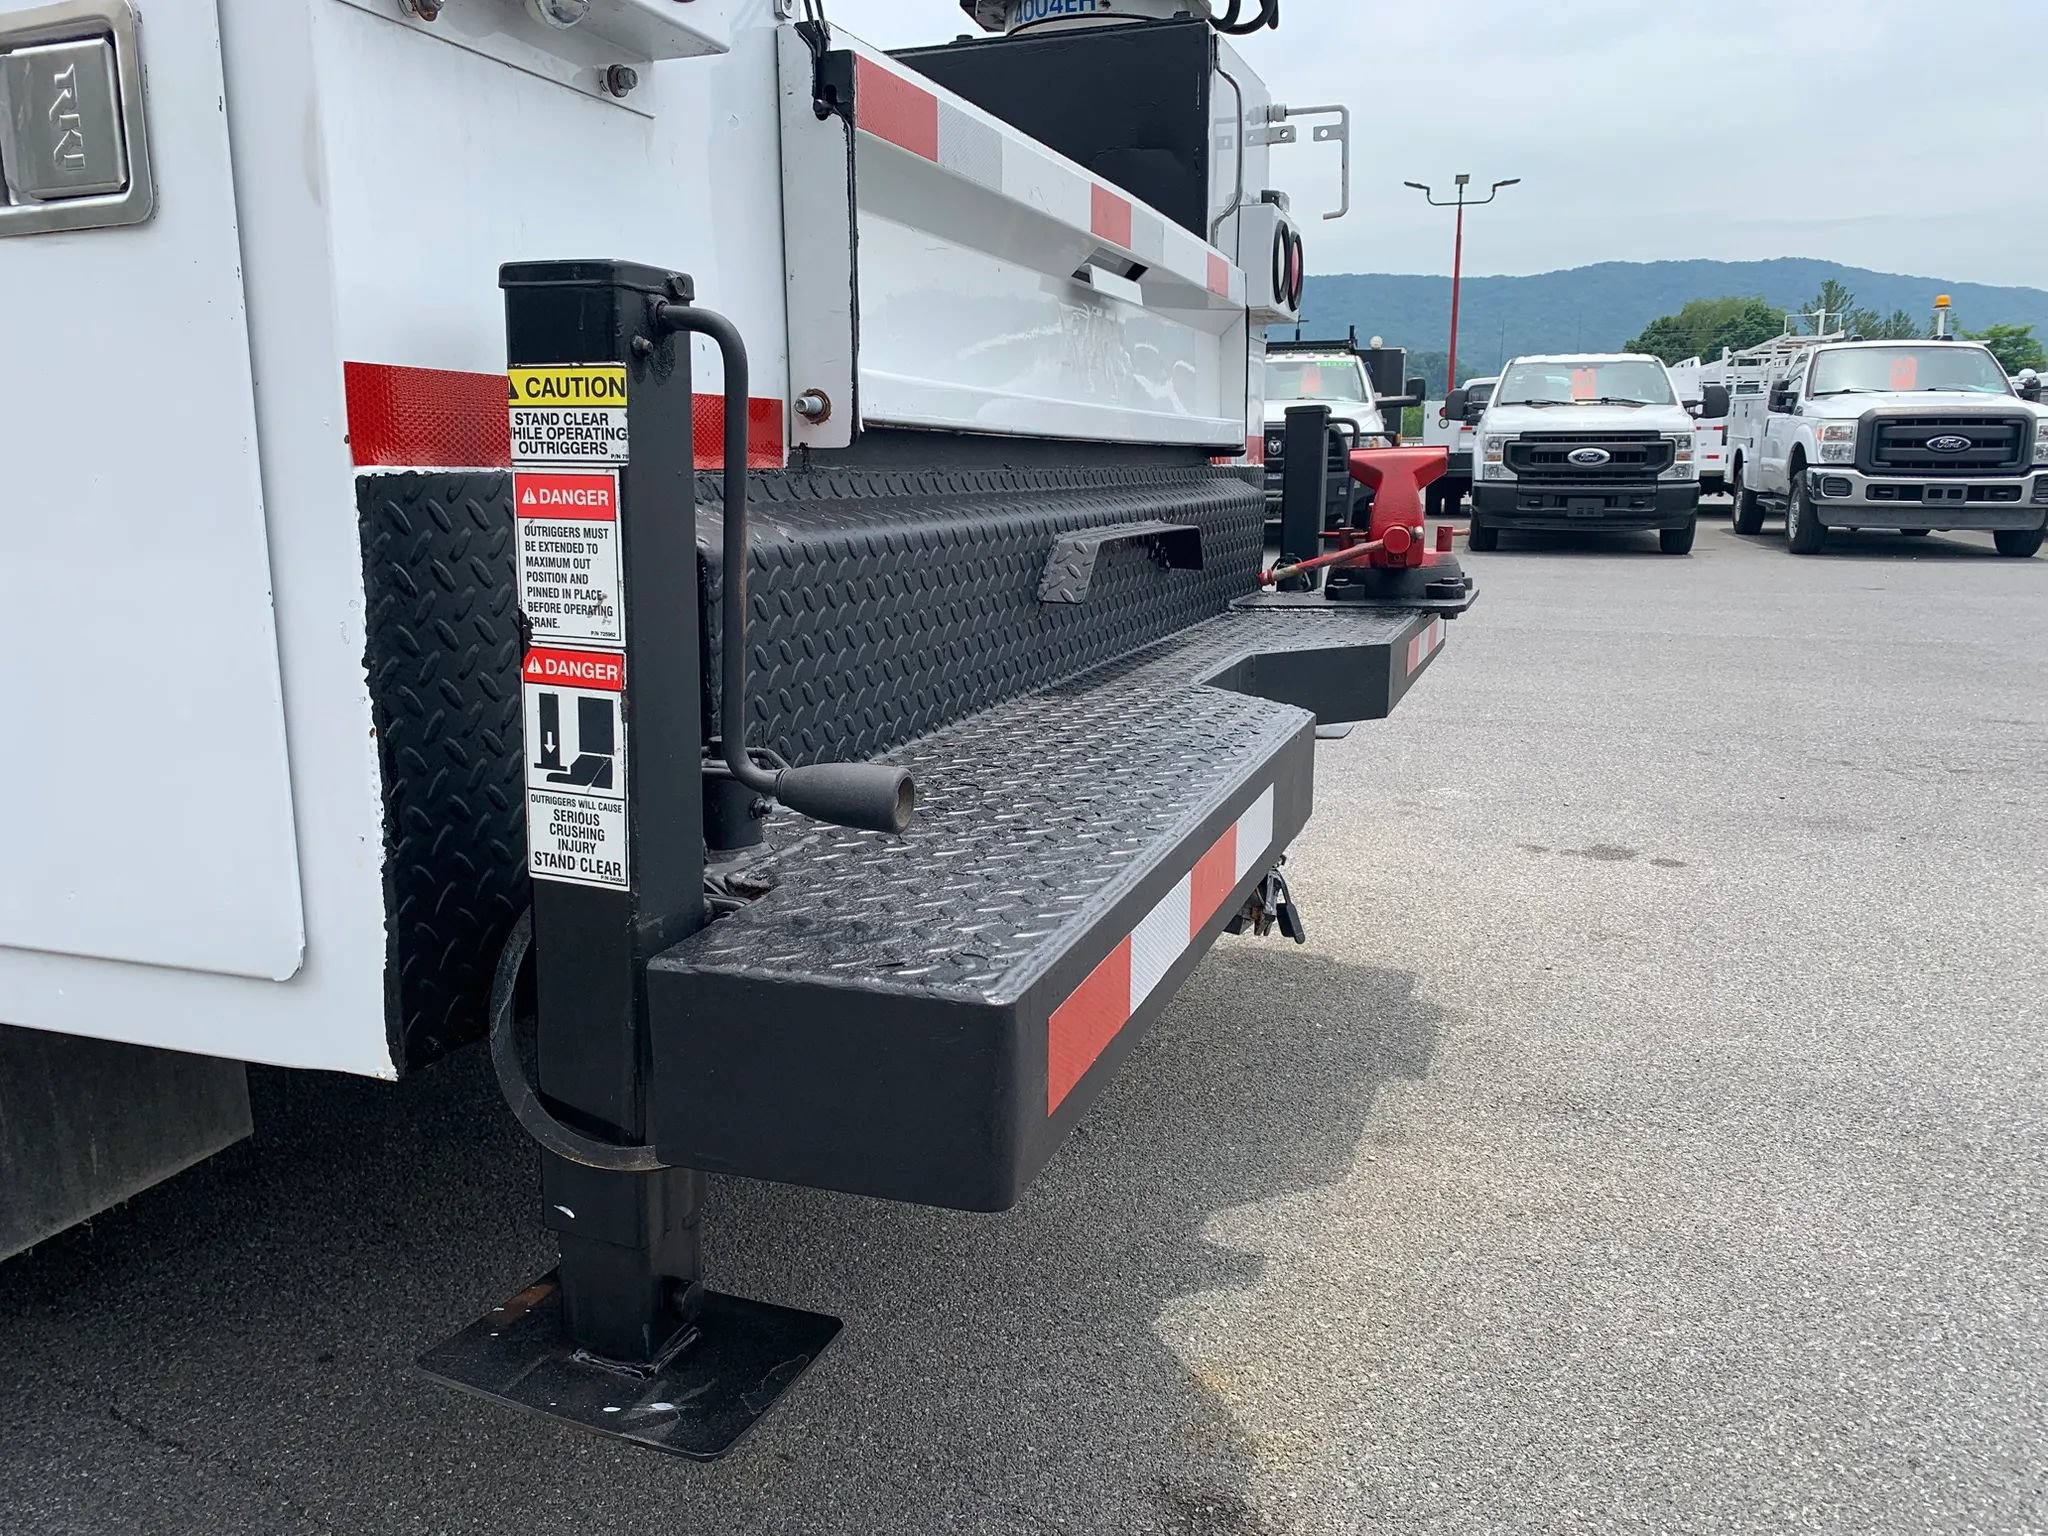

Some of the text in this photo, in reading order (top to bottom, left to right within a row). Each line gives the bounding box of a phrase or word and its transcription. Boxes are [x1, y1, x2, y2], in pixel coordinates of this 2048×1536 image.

[525, 376, 626, 398] CAUTION
[515, 412, 609, 426] STAND CLEAR
[510, 426, 627, 441] HILE OPERATING
[518, 441, 608, 455] OUTRIGGERS
[539, 488, 609, 506] DANGER
[524, 525, 609, 539] OUTRIGGERS MUST
[525, 541, 598, 555] BE EXTENDED TO
[525, 556, 591, 569] MAXIMUM OUT
[526, 571, 589, 585] POSITION AND
[527, 586, 602, 601] PINNED IN PLACE
[528, 601, 613, 617] BEFORE OPERATING
[545, 658, 619, 681] DANGER
[530, 793, 622, 814] OUTRIGGERS WILL CAUSE
[553, 808, 600, 827] SERIOUS
[549, 822, 605, 842] CRUSHING
[558, 838, 597, 855] INJURY
[534, 851, 622, 878] STAND CLEAR
